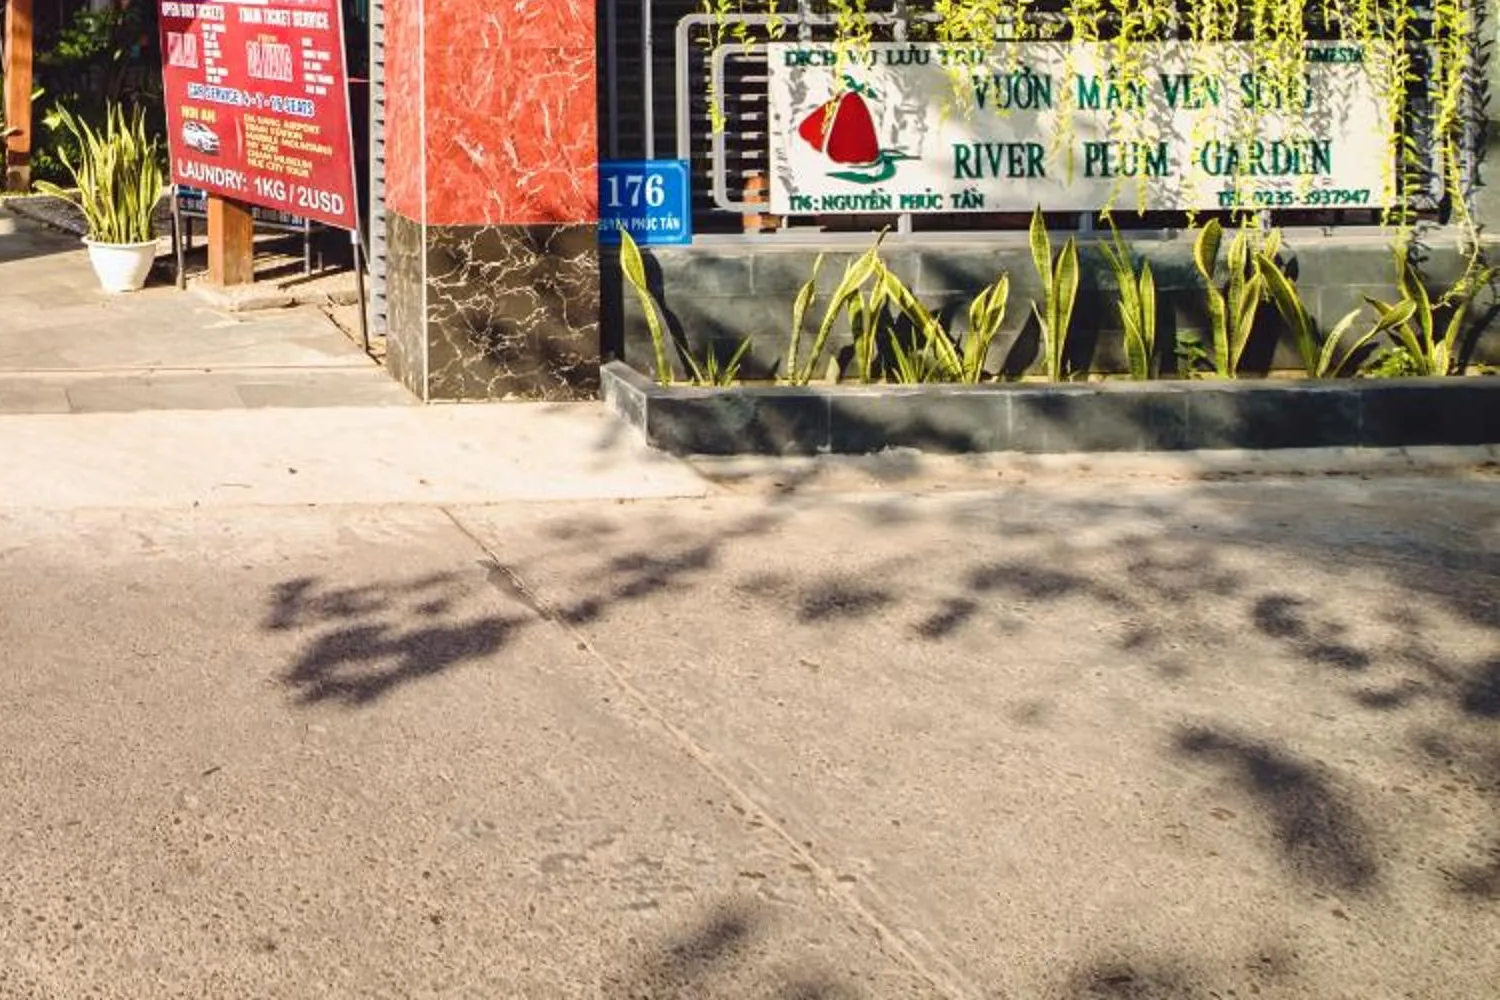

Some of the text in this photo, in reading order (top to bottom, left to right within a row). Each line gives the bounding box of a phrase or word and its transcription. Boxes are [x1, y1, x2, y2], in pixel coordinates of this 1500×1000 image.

[952, 138, 1332, 179] RIVER PLUM GARDEN
[177, 158, 248, 193] LAUNDRY:
[254, 175, 287, 202] 1KG
[297, 186, 345, 216] 2USD
[607, 173, 665, 208] 176
